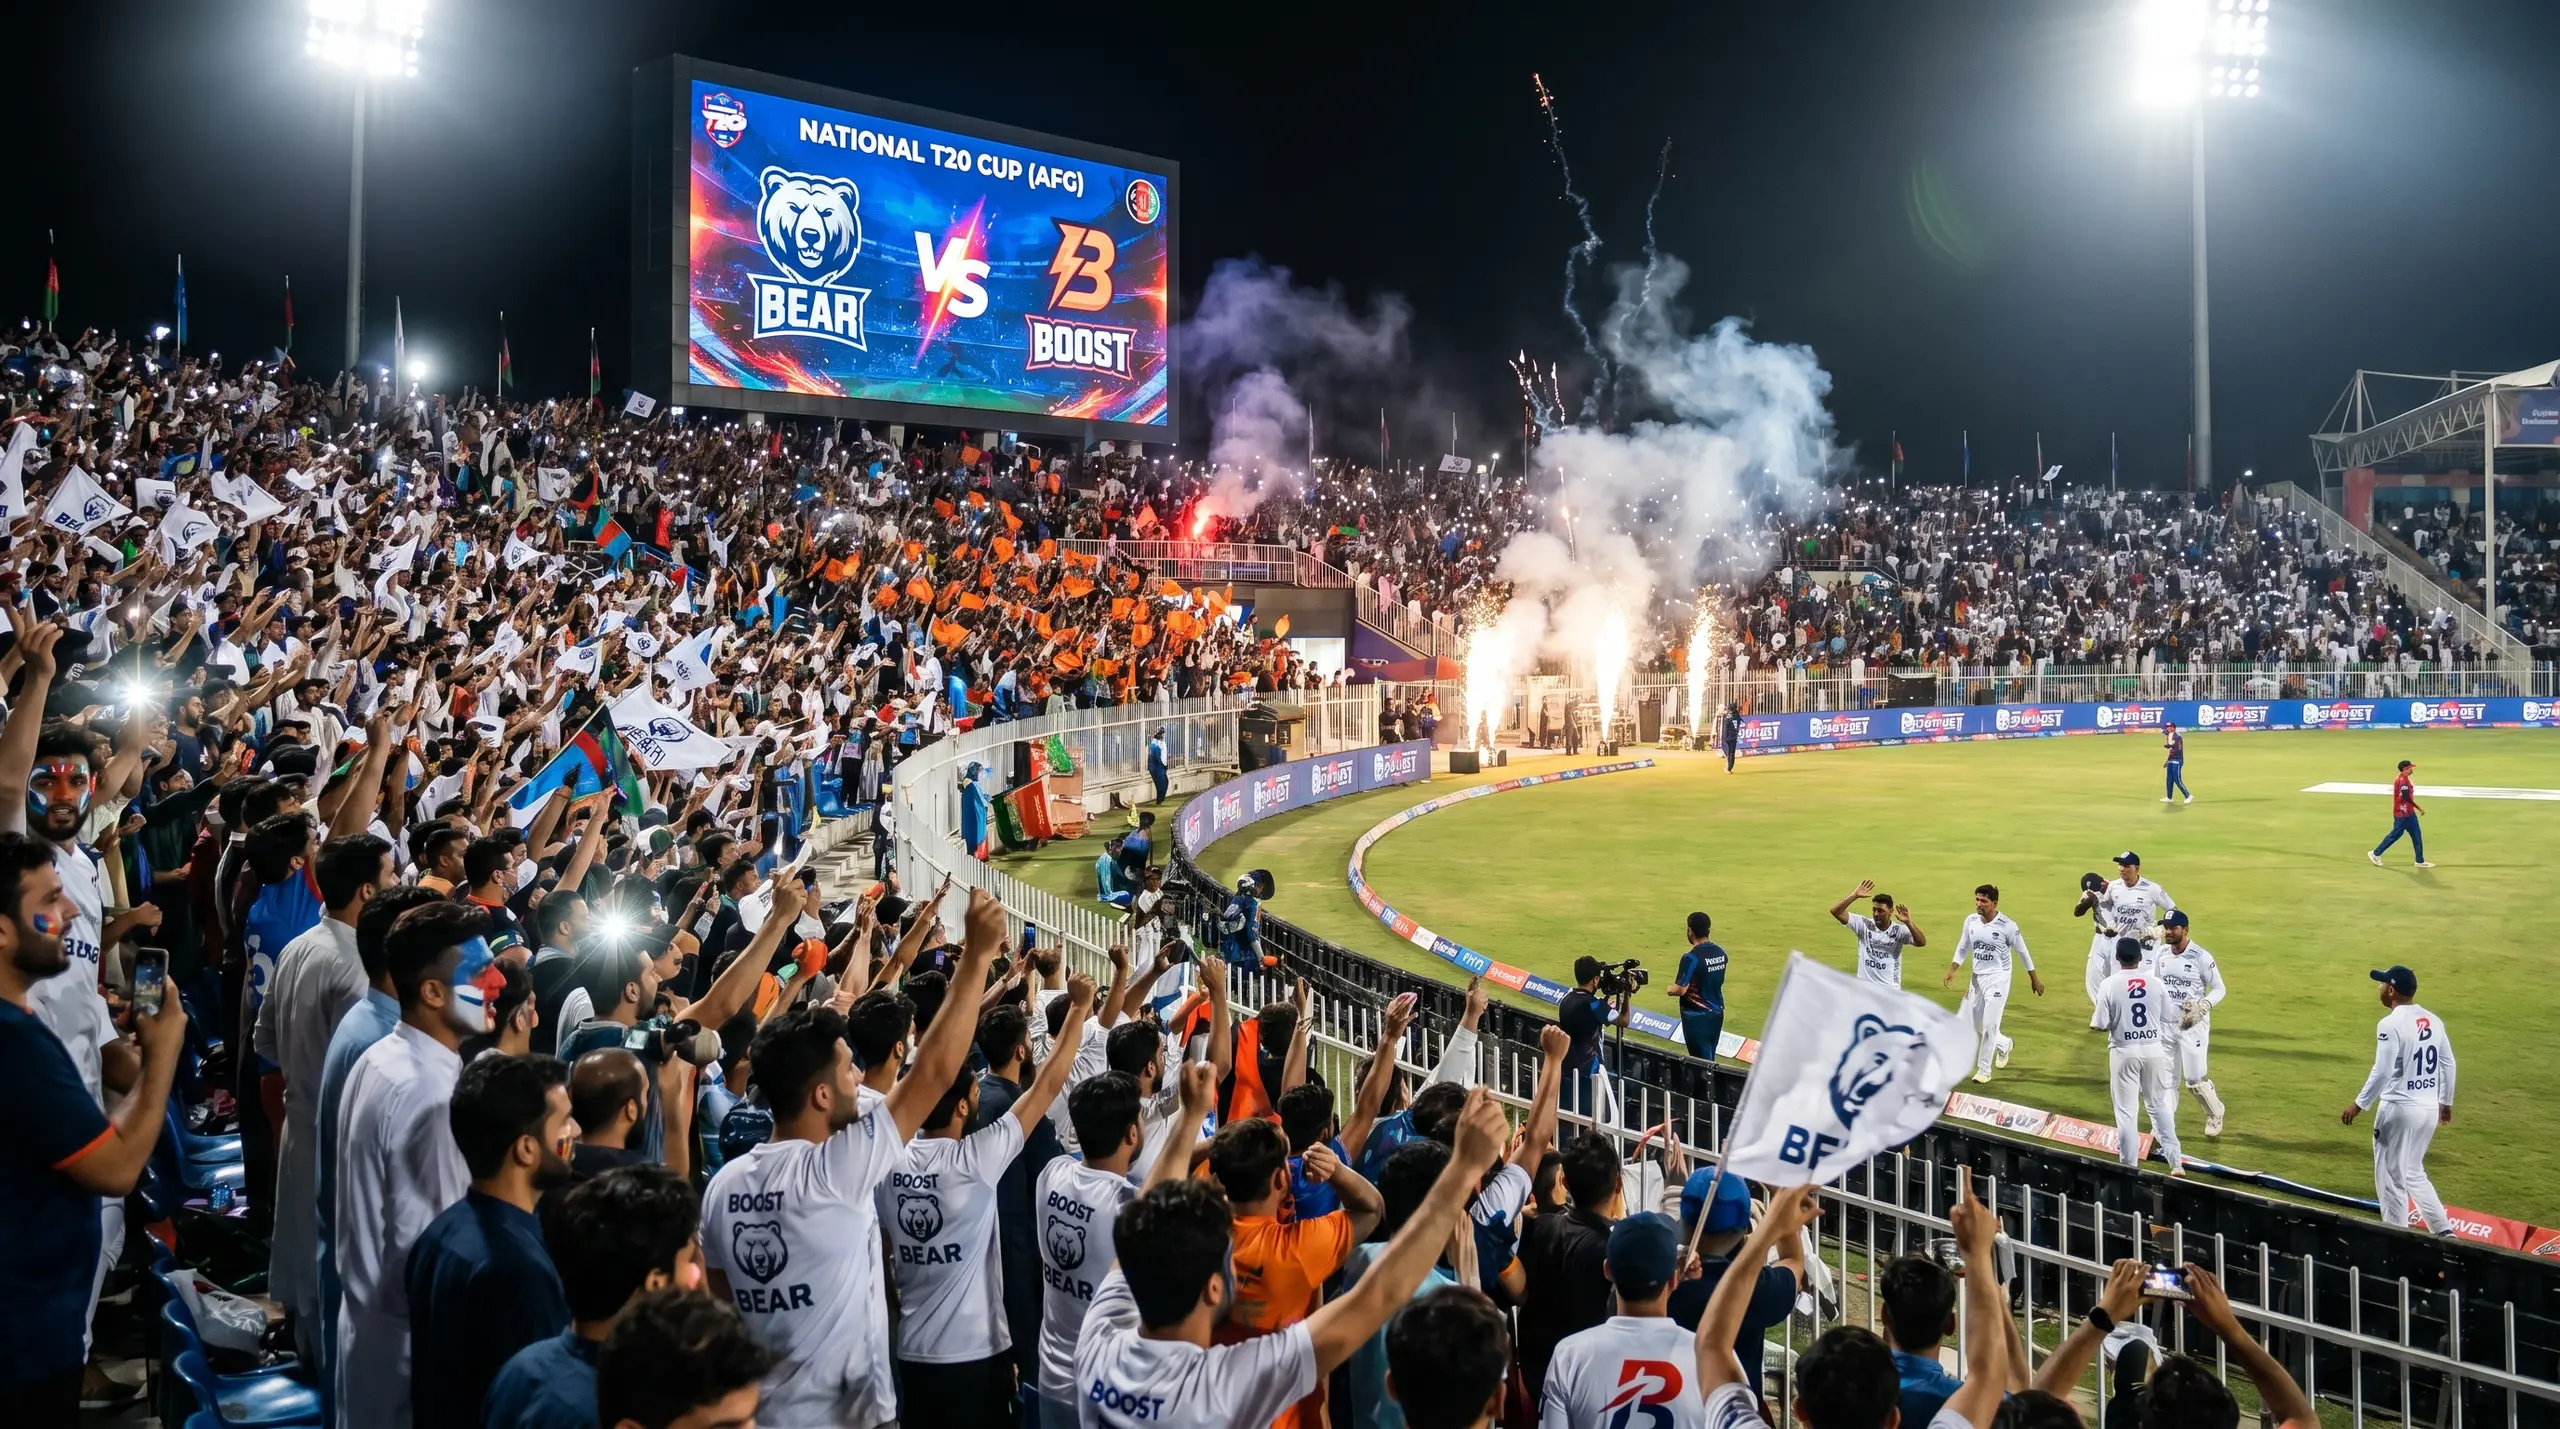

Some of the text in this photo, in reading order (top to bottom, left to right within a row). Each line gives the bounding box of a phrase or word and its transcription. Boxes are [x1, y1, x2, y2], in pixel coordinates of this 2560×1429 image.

[799, 117, 1084, 198] NATIONAL T20 CUP (AFG)
[914, 231, 991, 318] VS
[761, 283, 858, 339] BEAR
[1033, 322, 1131, 372] BOOST
[2130, 1002, 2148, 1028] 8
[2413, 1044, 2438, 1076] 19
[1778, 1123, 1849, 1171] BE
[892, 1171, 939, 1189] BOOST
[727, 1190, 785, 1214] BOOST
[1047, 1190, 1096, 1224] BOOST
[899, 1242, 963, 1266] BEAR
[735, 1282, 815, 1314] BEAR
[1043, 1263, 1094, 1301] BEAR
[1089, 1379, 1165, 1421] BOOST
